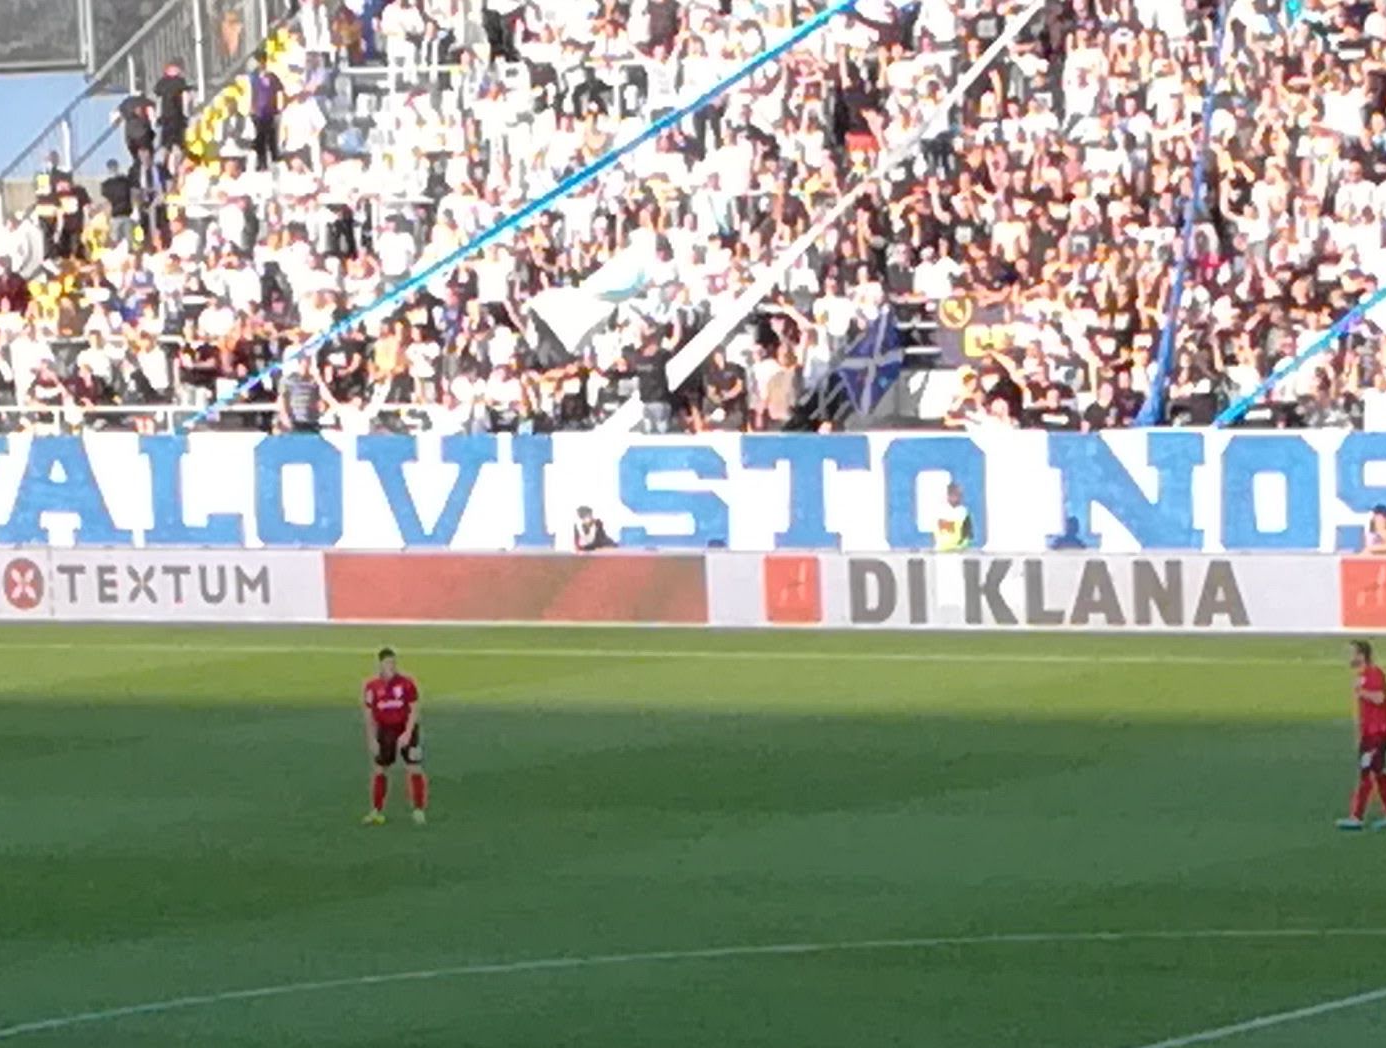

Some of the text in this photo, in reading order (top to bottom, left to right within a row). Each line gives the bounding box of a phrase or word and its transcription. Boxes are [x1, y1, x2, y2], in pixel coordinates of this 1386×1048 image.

[618, 433, 987, 550] STO
[56, 564, 271, 604] TEXTUM
[849, 558, 1251, 626] DI KLANA
